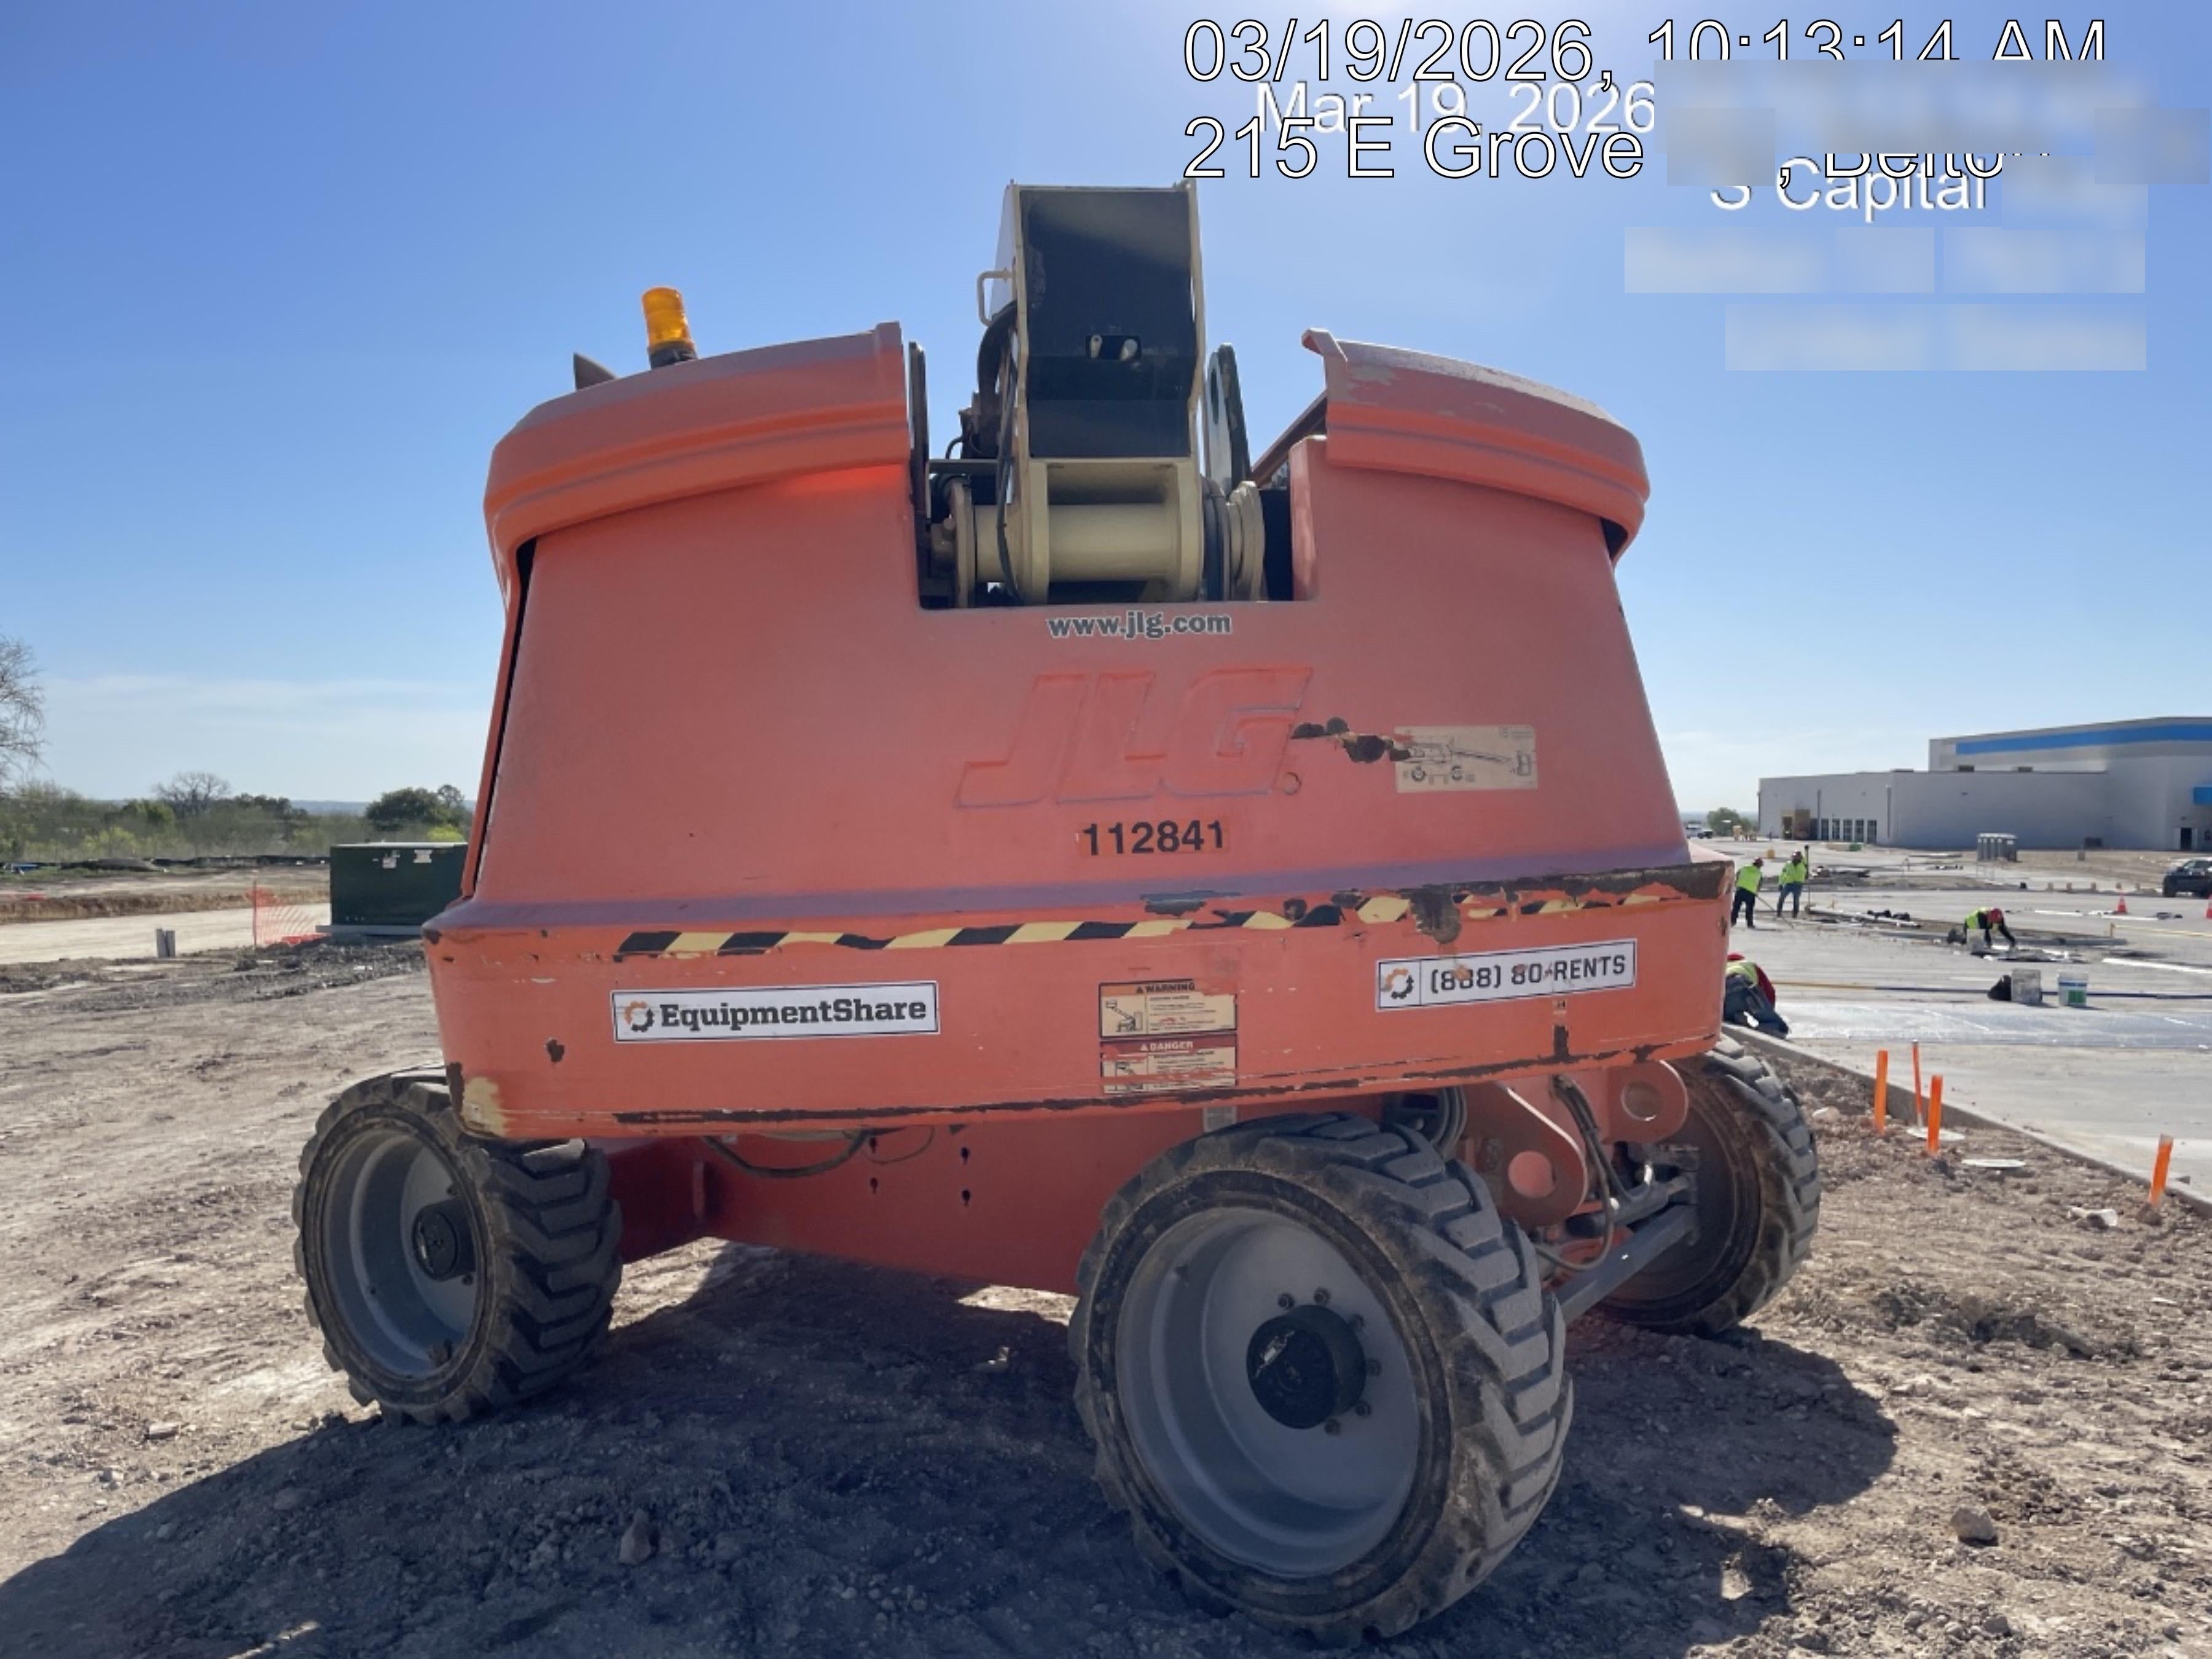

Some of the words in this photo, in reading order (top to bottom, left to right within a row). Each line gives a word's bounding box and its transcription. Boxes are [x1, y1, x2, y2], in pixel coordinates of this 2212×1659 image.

[1046, 611, 1231, 639] www.jlg.com
[954, 667, 1314, 809] JLG
[1083, 820, 1224, 855] 112841
[1145, 982, 1195, 993] WARNING
[660, 999, 927, 1031] EquipmentShare
[1149, 1041, 1193, 1052] DANGER
